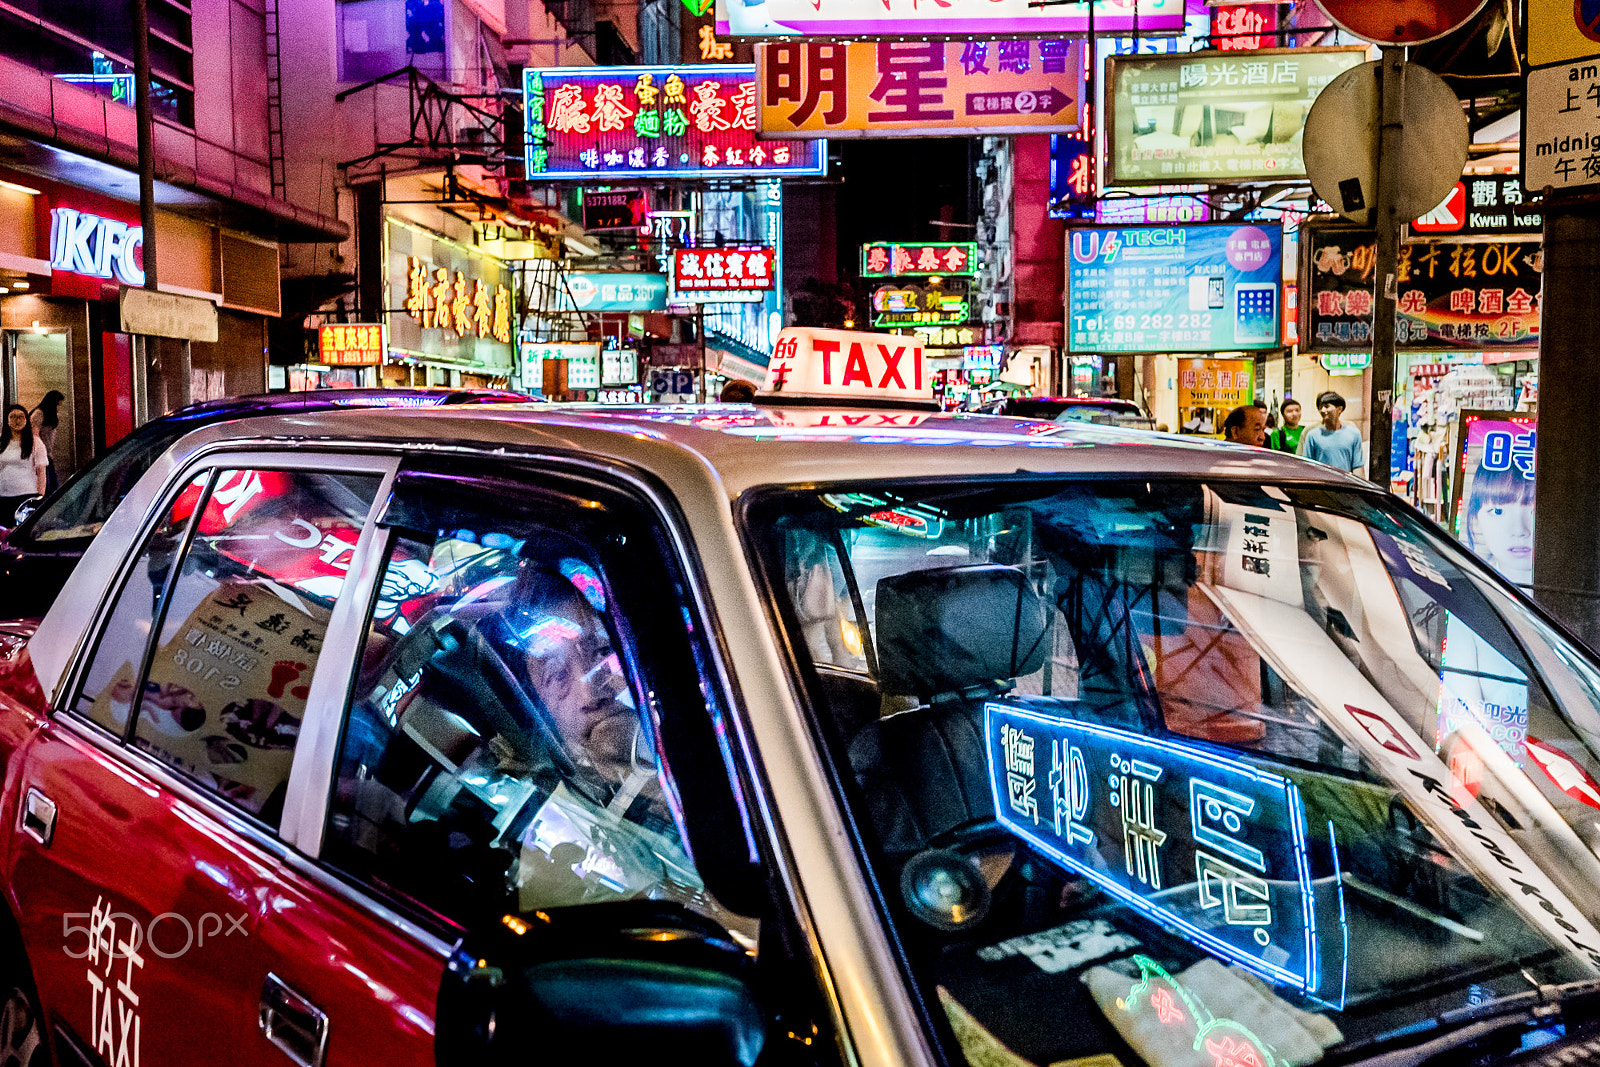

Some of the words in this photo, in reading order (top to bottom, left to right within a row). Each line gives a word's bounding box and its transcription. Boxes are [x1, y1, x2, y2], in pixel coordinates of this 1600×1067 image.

[766, 42, 954, 127] 明星
[1180, 61, 1299, 88] 陽光酒店
[1569, 65, 1597, 81] am
[1469, 212, 1507, 228] Kwun
[50, 207, 146, 286] KFC
[1317, 289, 1426, 316] 歡樂光
[1074, 316, 1108, 330] Tel:
[1114, 315, 1135, 329] 69
[1140, 314, 1174, 329] 282
[1178, 314, 1212, 329] 282
[813, 340, 922, 390] TAXI
[1182, 370, 1250, 390] 陽光酒店
[88, 894, 144, 1007] 的士
[87, 968, 141, 1067] TAXI
